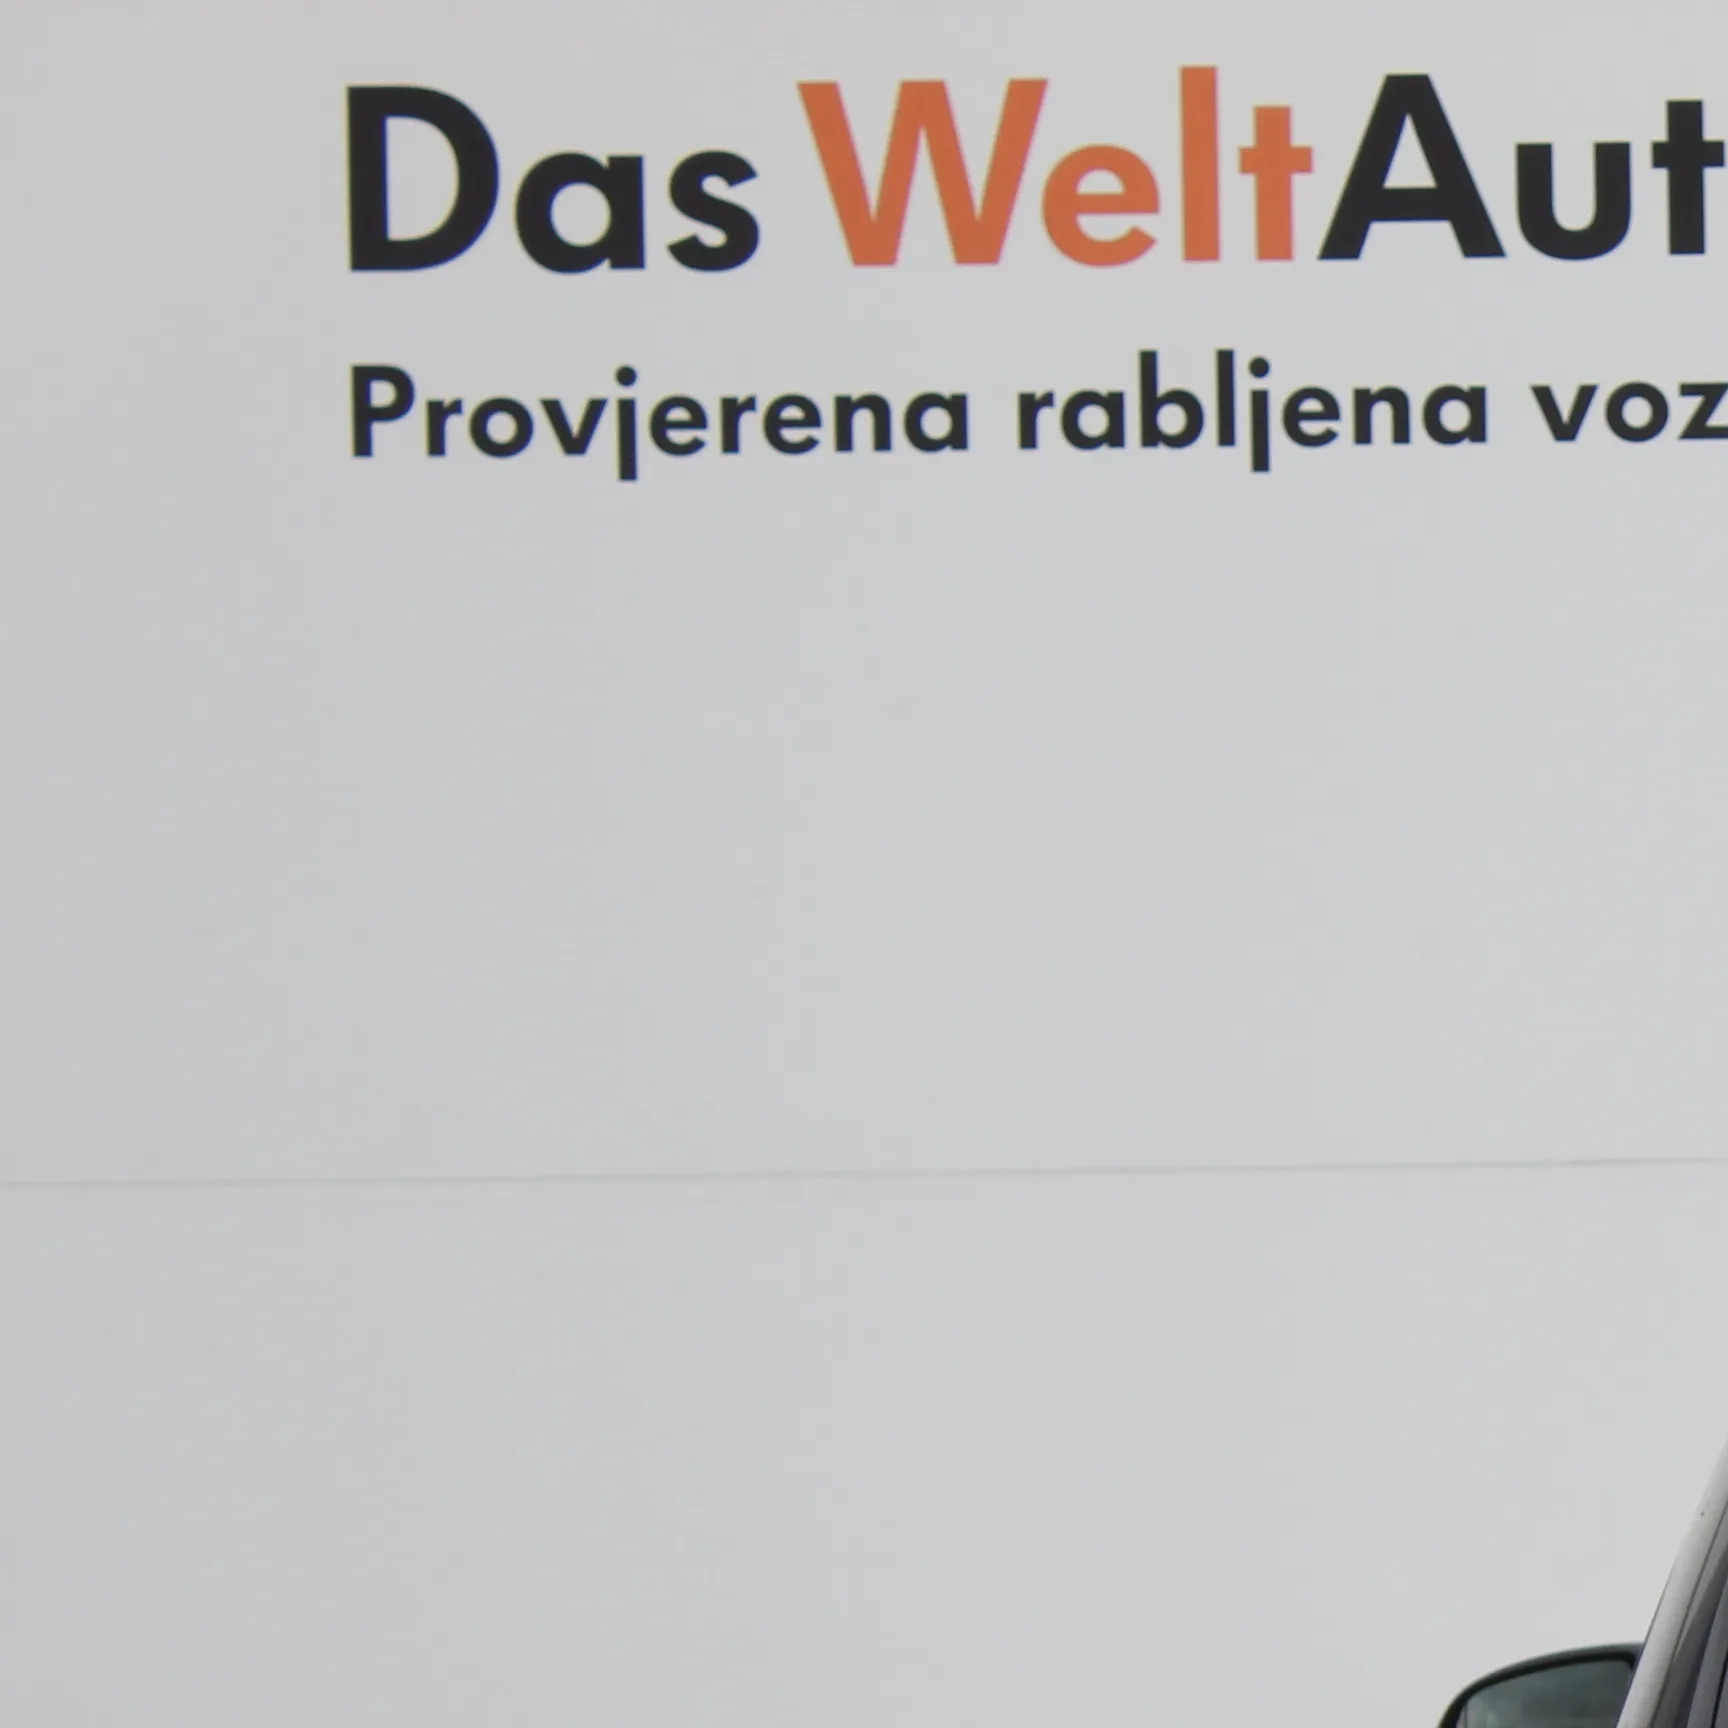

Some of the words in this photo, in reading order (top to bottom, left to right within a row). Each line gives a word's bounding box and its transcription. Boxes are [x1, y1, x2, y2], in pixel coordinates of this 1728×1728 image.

[346, 84, 761, 275] Das
[350, 364, 969, 482] Provjerena
[1017, 348, 1488, 474] rabljena
